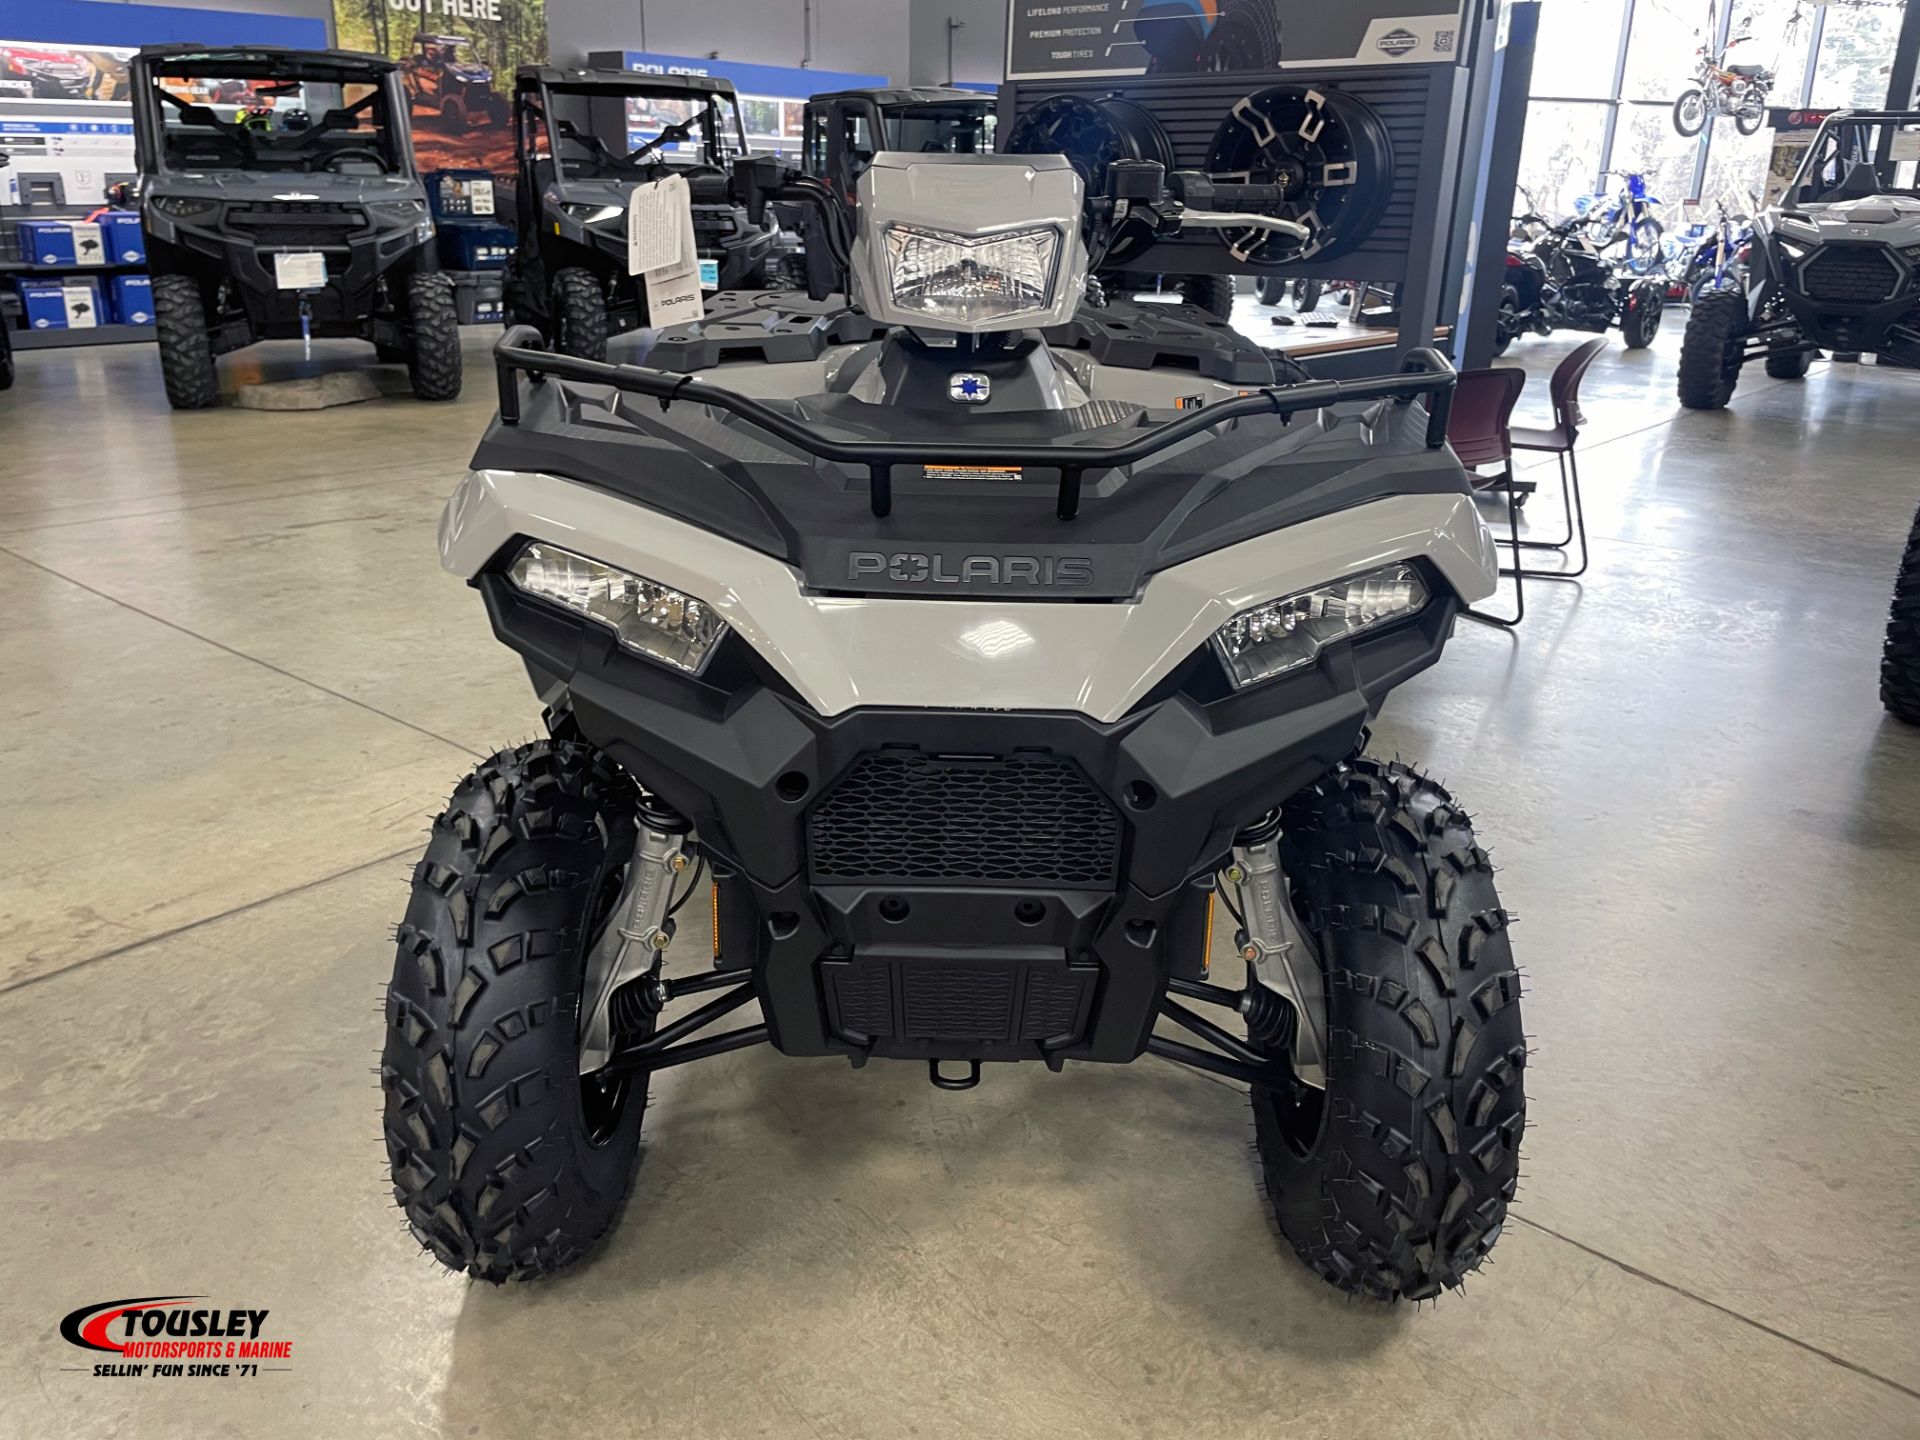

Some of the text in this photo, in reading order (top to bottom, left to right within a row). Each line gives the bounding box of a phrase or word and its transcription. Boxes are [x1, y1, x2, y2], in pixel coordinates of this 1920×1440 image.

[442, 0, 502, 21] HERE
[1027, 7, 1061, 17] LIFELONG
[1073, 50, 1094, 58] TIRES
[661, 295, 695, 307] POLARIS
[848, 552, 1094, 587] POLARIS
